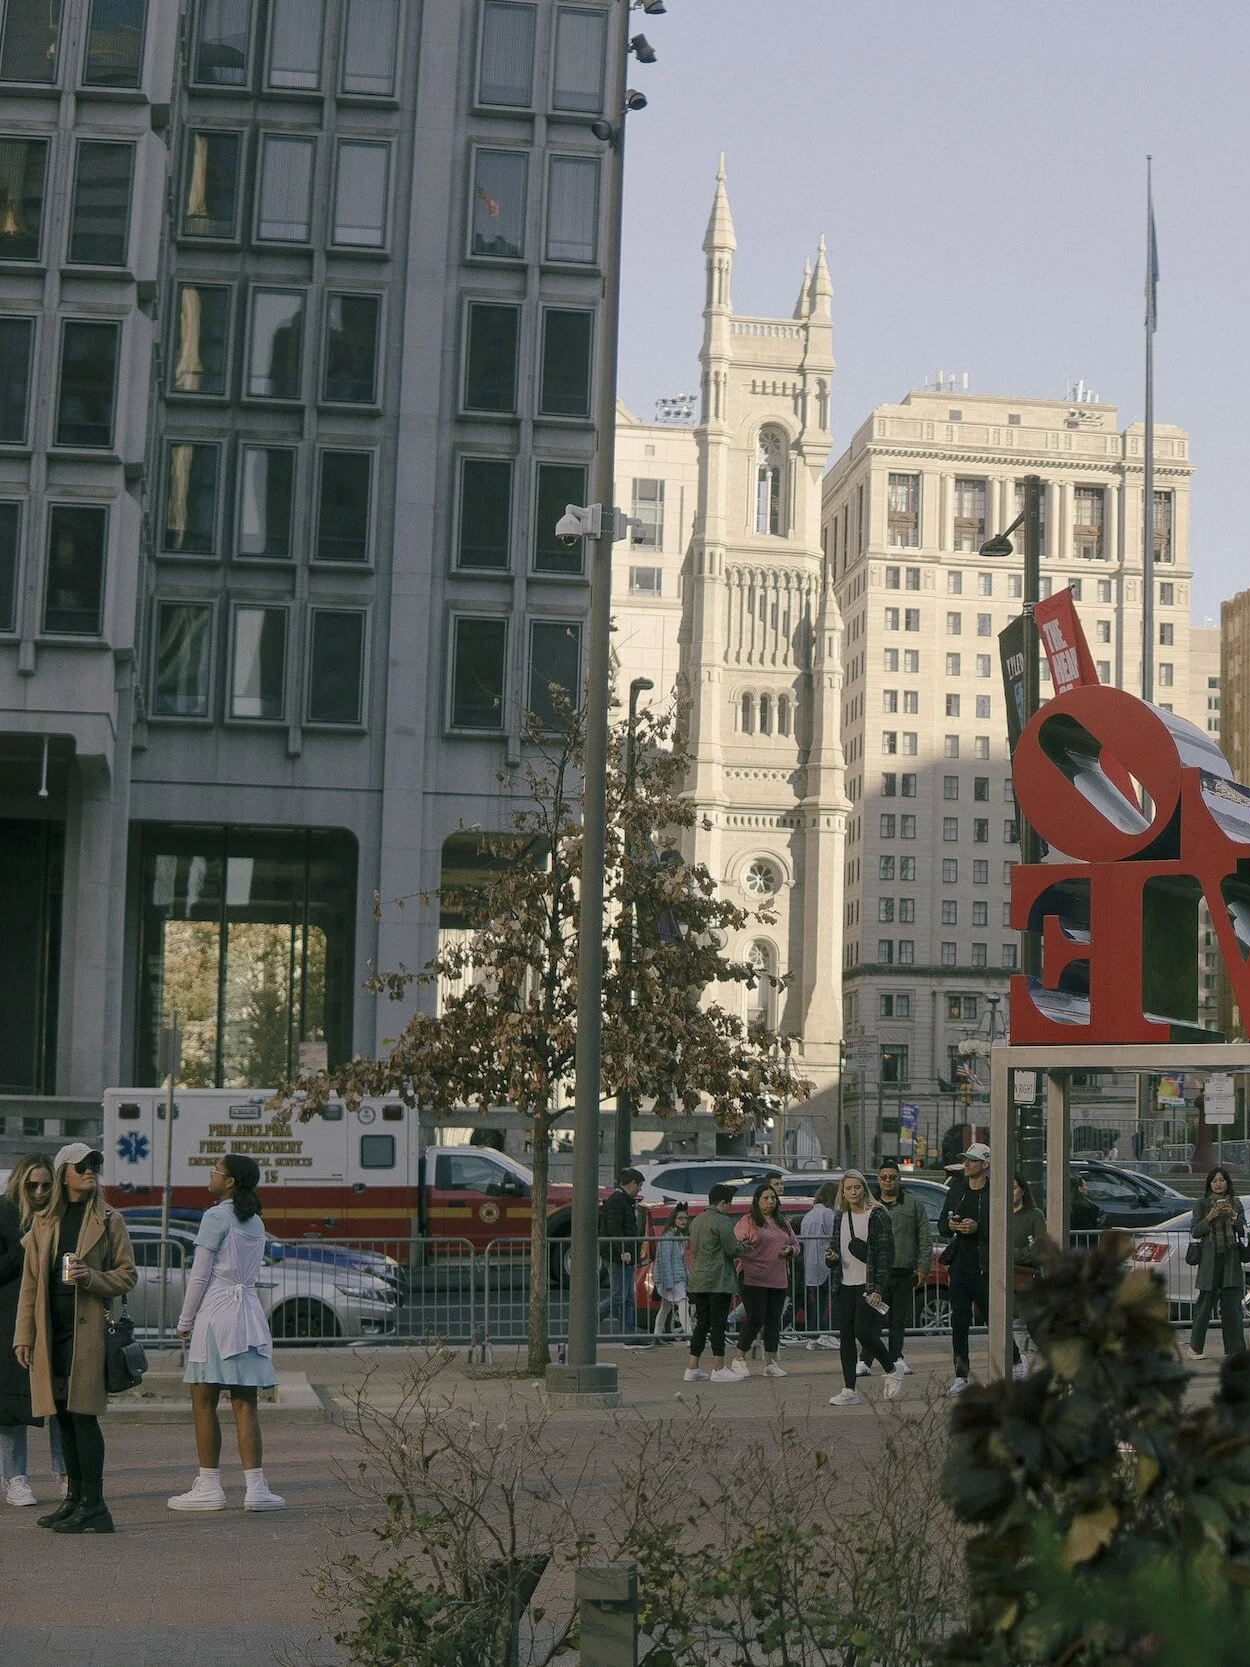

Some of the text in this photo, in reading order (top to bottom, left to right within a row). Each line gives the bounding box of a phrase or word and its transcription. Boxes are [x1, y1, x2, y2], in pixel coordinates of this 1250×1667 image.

[1041, 618, 1068, 653] THE
[1052, 646, 1080, 685] HEAR
[208, 1123, 294, 1137] PHILADELPHIA
[199, 1140, 304, 1154] FIRE DEPARTMENT
[275, 1157, 313, 1167] SERVICES
[264, 1169, 279, 1183] 15
